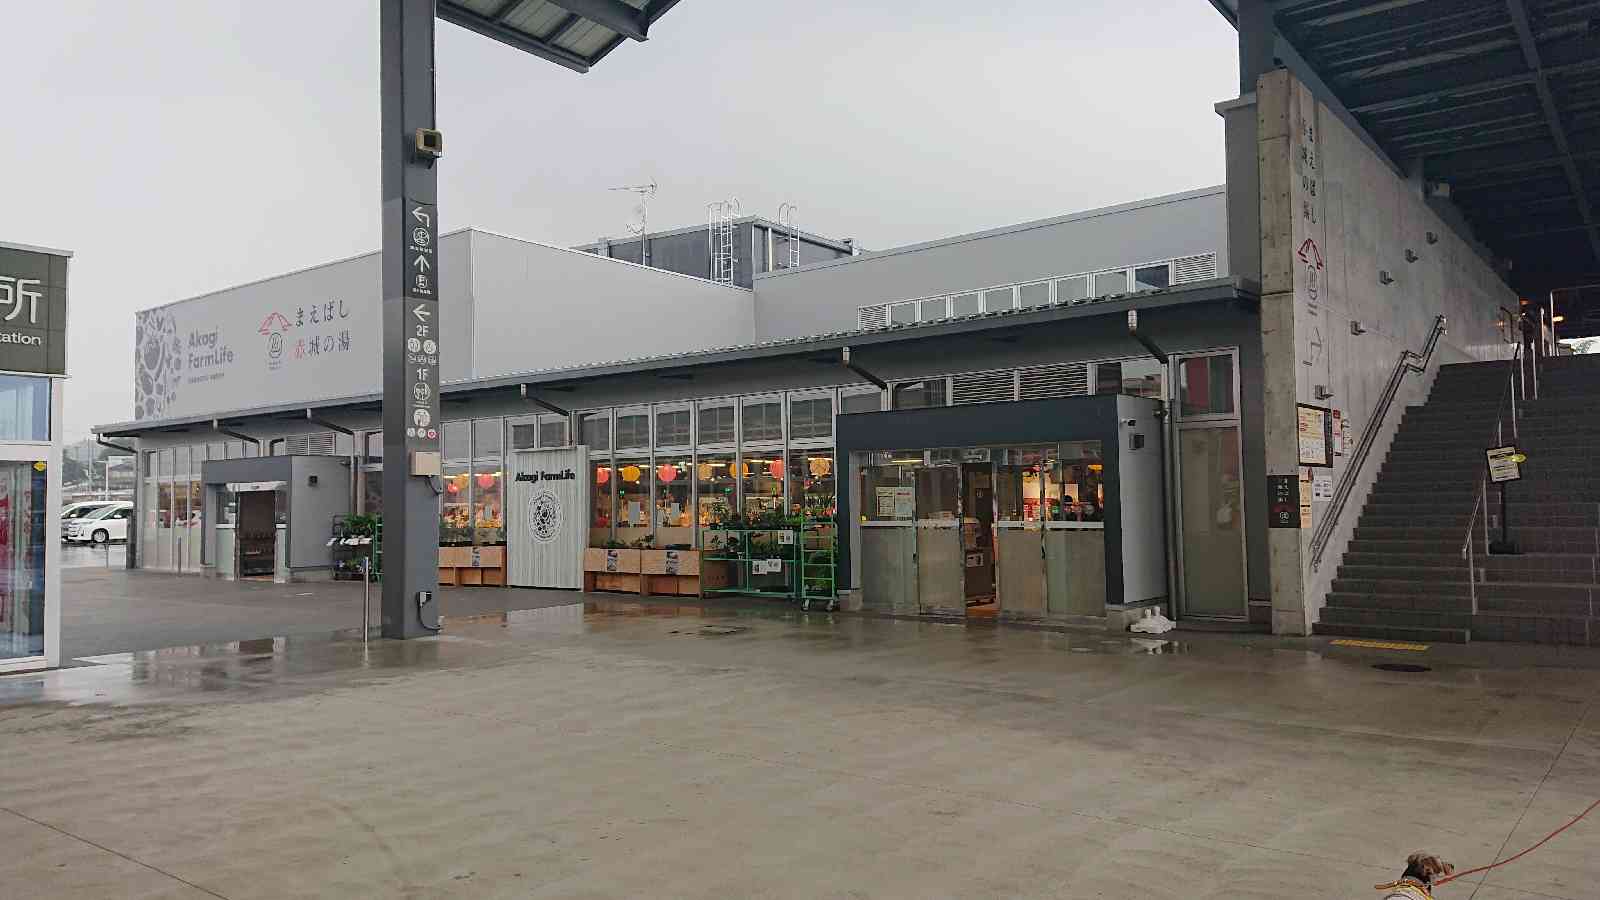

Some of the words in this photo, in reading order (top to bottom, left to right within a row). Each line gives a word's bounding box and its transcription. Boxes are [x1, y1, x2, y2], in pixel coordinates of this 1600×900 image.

[295, 298, 349, 328] まえばし
[188, 325, 219, 349] Akagi
[416, 324, 430, 337] 2F
[294, 328, 351, 360] 赤城の湯
[187, 346, 234, 370] FarmLife
[416, 368, 429, 381] 1F
[515, 471, 539, 484] Akagi
